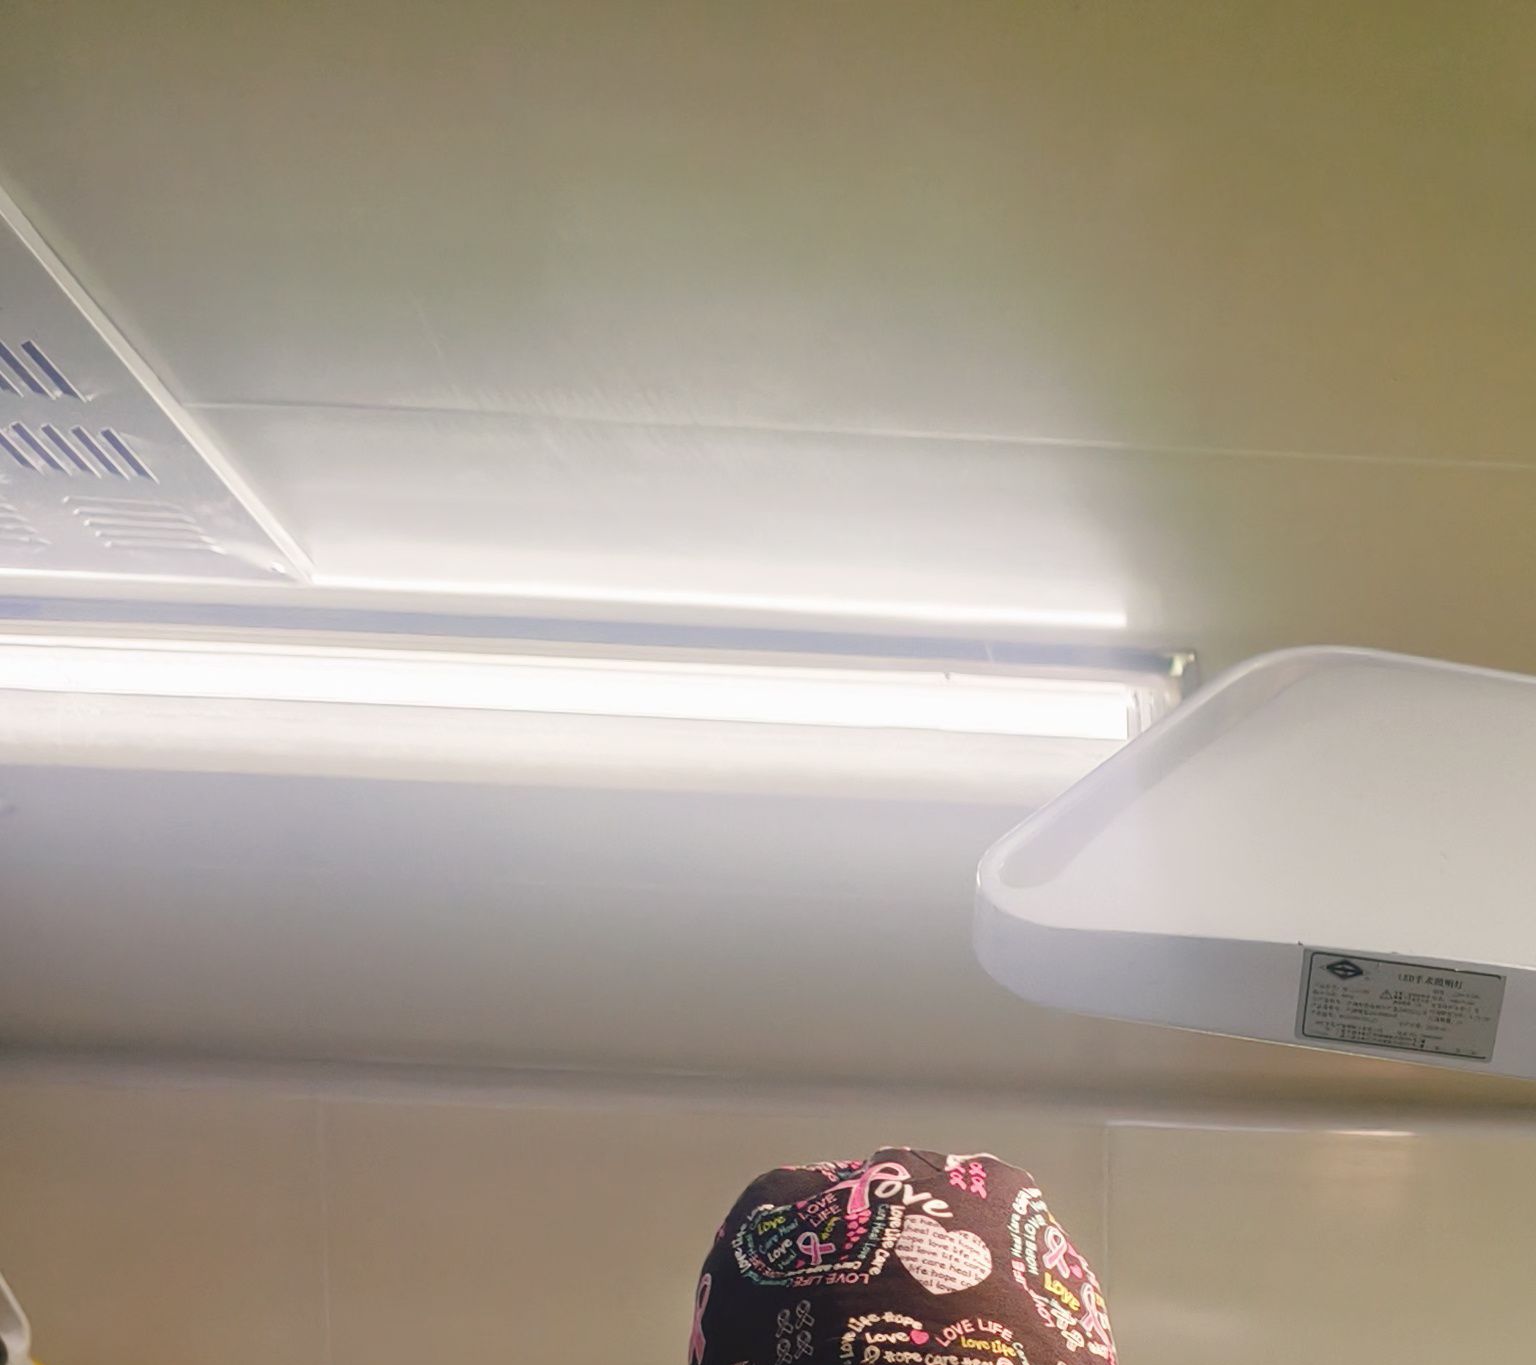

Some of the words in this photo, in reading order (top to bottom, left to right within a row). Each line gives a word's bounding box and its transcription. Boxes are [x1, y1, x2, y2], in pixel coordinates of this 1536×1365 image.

[864, 1331, 911, 1345] Love
[935, 1318, 975, 1347] LOVE
[977, 1318, 1014, 1342] LIFE
